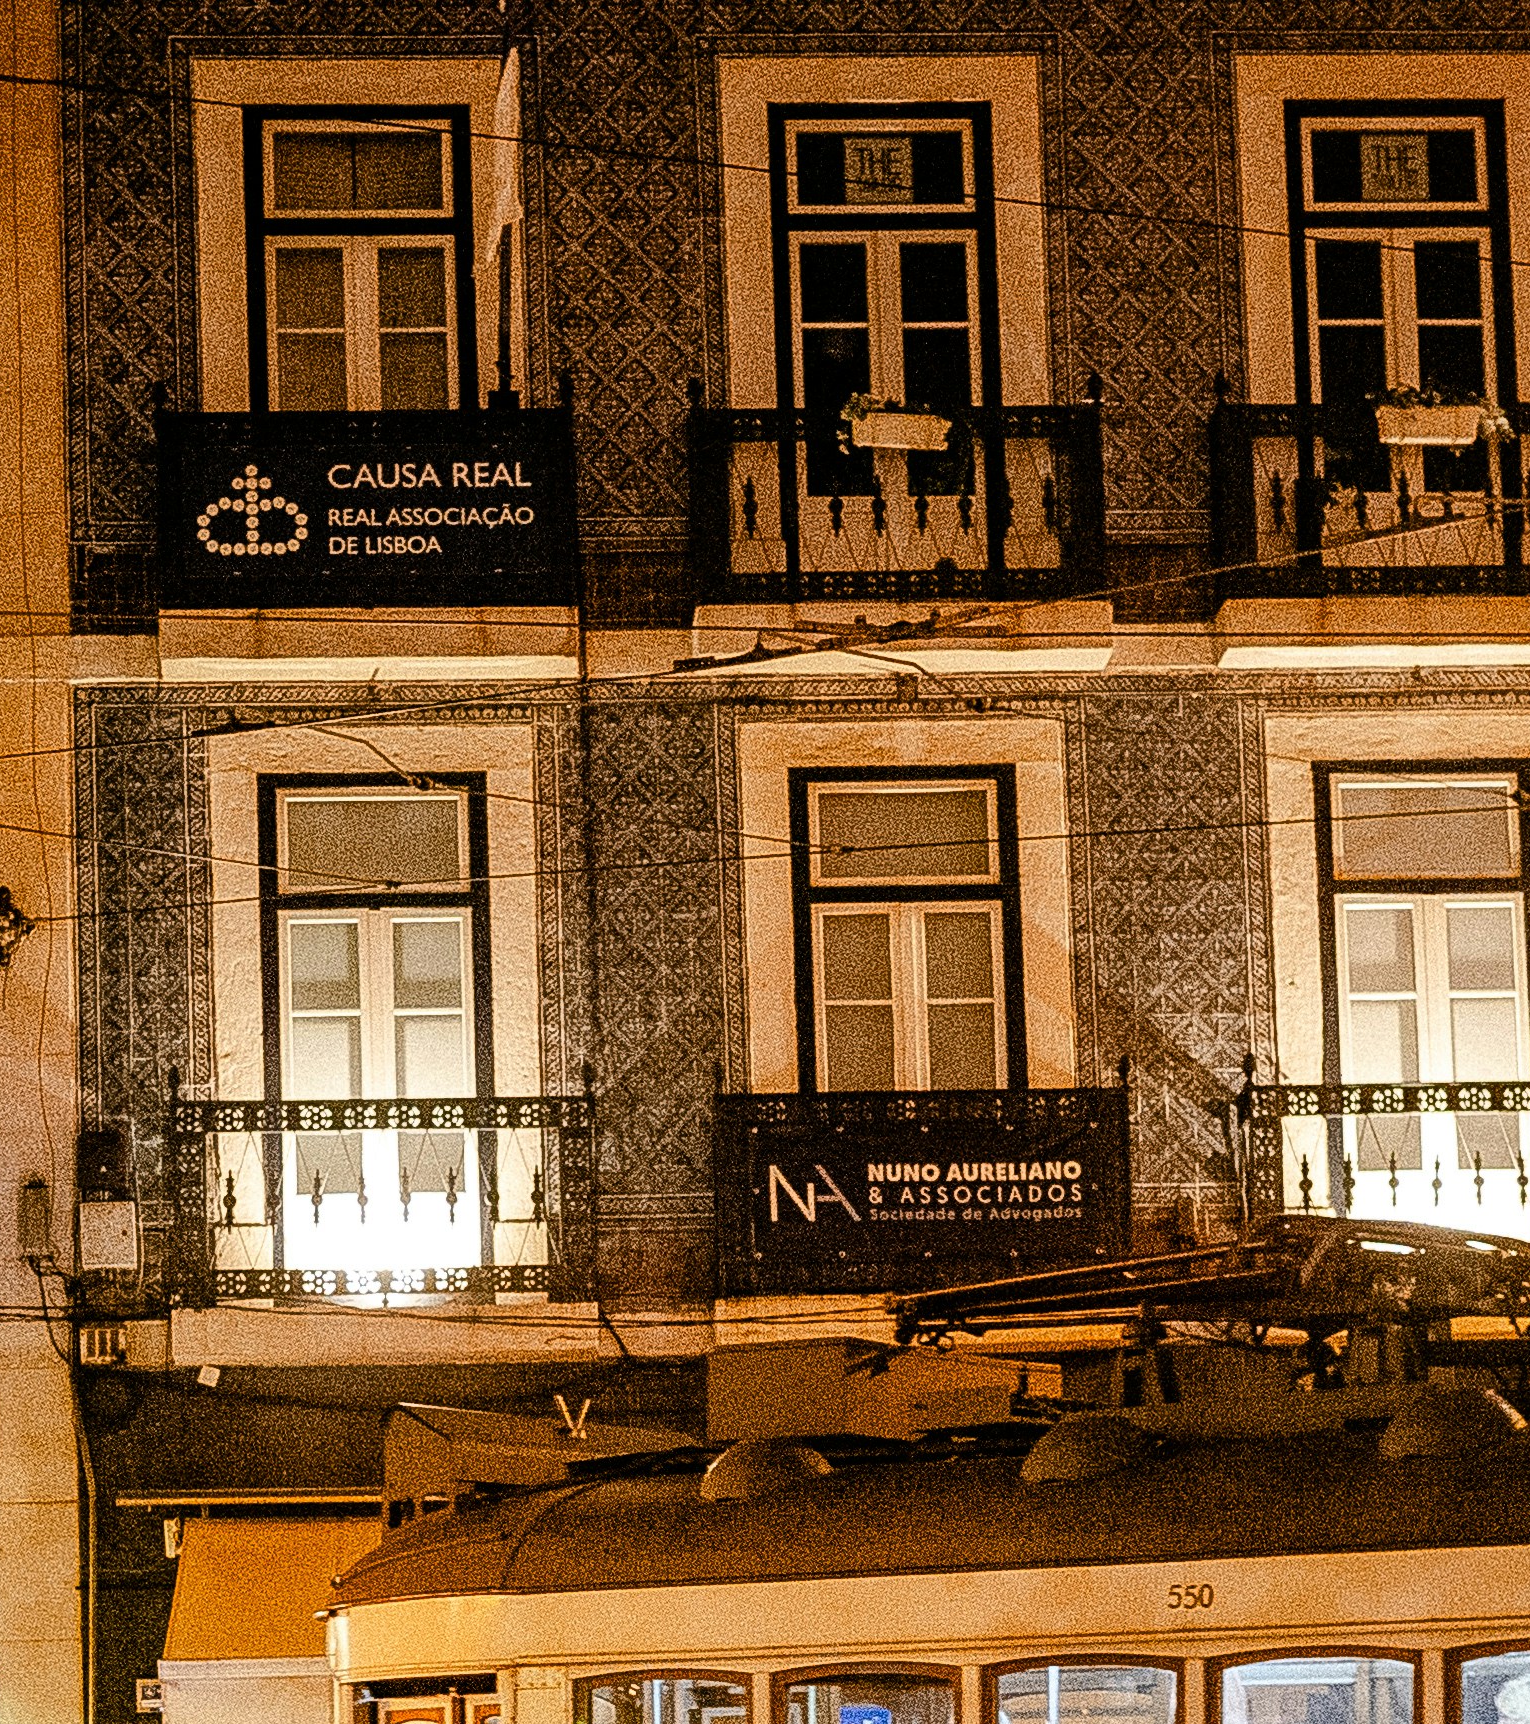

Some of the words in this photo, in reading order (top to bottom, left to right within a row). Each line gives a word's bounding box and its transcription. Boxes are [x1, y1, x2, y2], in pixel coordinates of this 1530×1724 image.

[327, 463, 442, 489] CAUSA
[452, 461, 532, 488] REAL
[328, 507, 384, 527] REAL
[387, 503, 534, 529] ASSOCIAÇÃO
[329, 536, 359, 555] DE
[365, 535, 443, 555] LISBOA
[868, 1163, 940, 1182] NUNO
[946, 1161, 1082, 1181] AURELIANO
[868, 1188, 883, 1204] &
[900, 1185, 1082, 1203] ASSOCIADOS
[870, 1207, 957, 1221] Sociedade
[962, 1207, 983, 1220] de
[989, 1206, 1083, 1222] Advogados
[1167, 1583, 1214, 1609] 550
